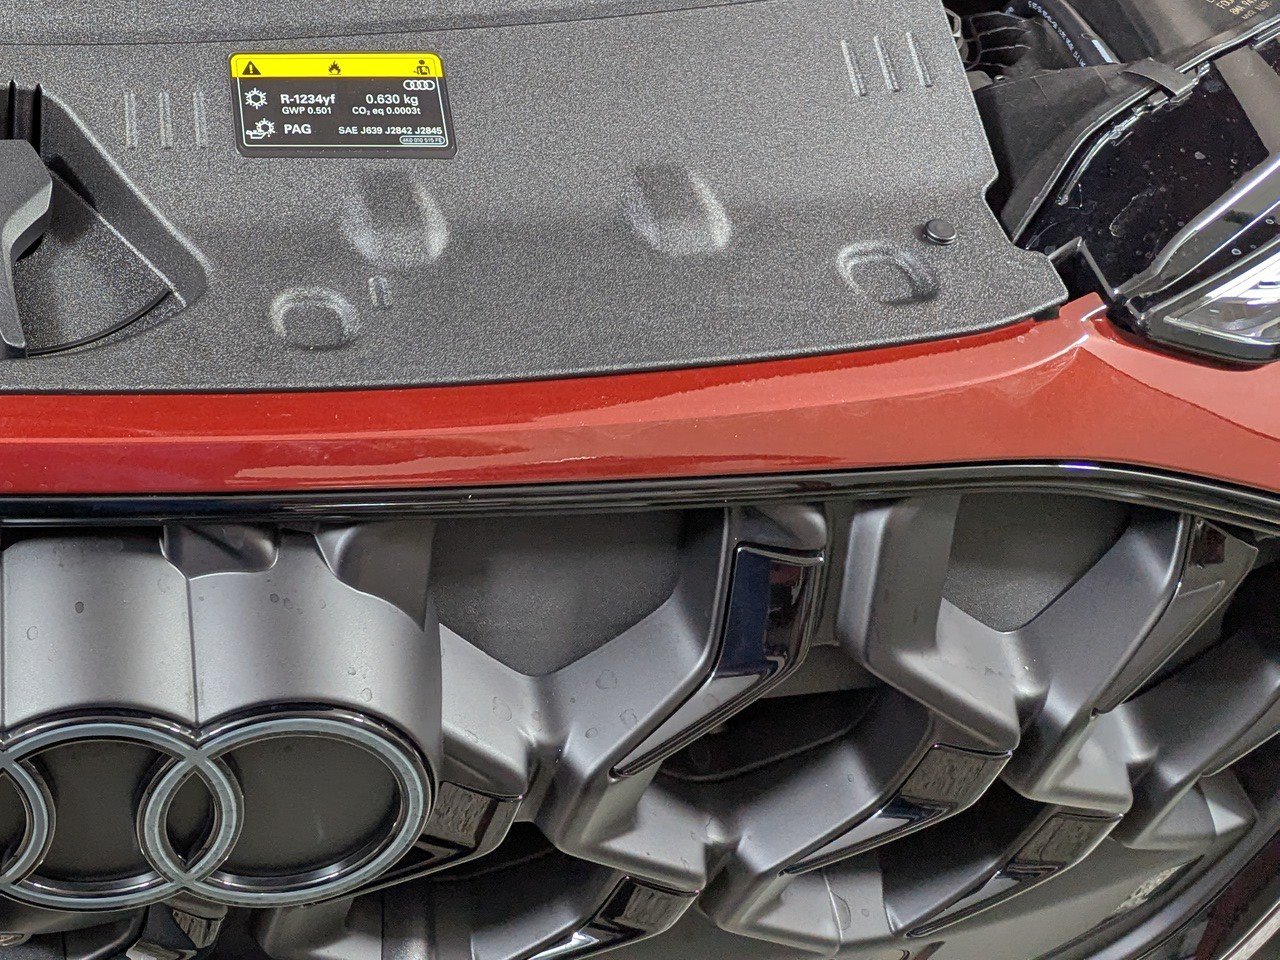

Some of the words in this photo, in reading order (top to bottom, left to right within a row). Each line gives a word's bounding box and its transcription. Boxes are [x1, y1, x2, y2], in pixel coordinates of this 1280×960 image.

[280, 94, 336, 106] R-1234yf
[365, 94, 400, 104] 0.630
[403, 94, 419, 106] kg
[281, 107, 306, 115] GWP
[307, 107, 332, 115] 0.501
[372, 108, 385, 116] eq
[386, 107, 421, 115] 0.0003t
[284, 124, 312, 135] PAG
[338, 126, 358, 135] SAE
[360, 126, 383, 135] J639
[384, 126, 413, 135] J2842
[414, 126, 443, 135] J2845
